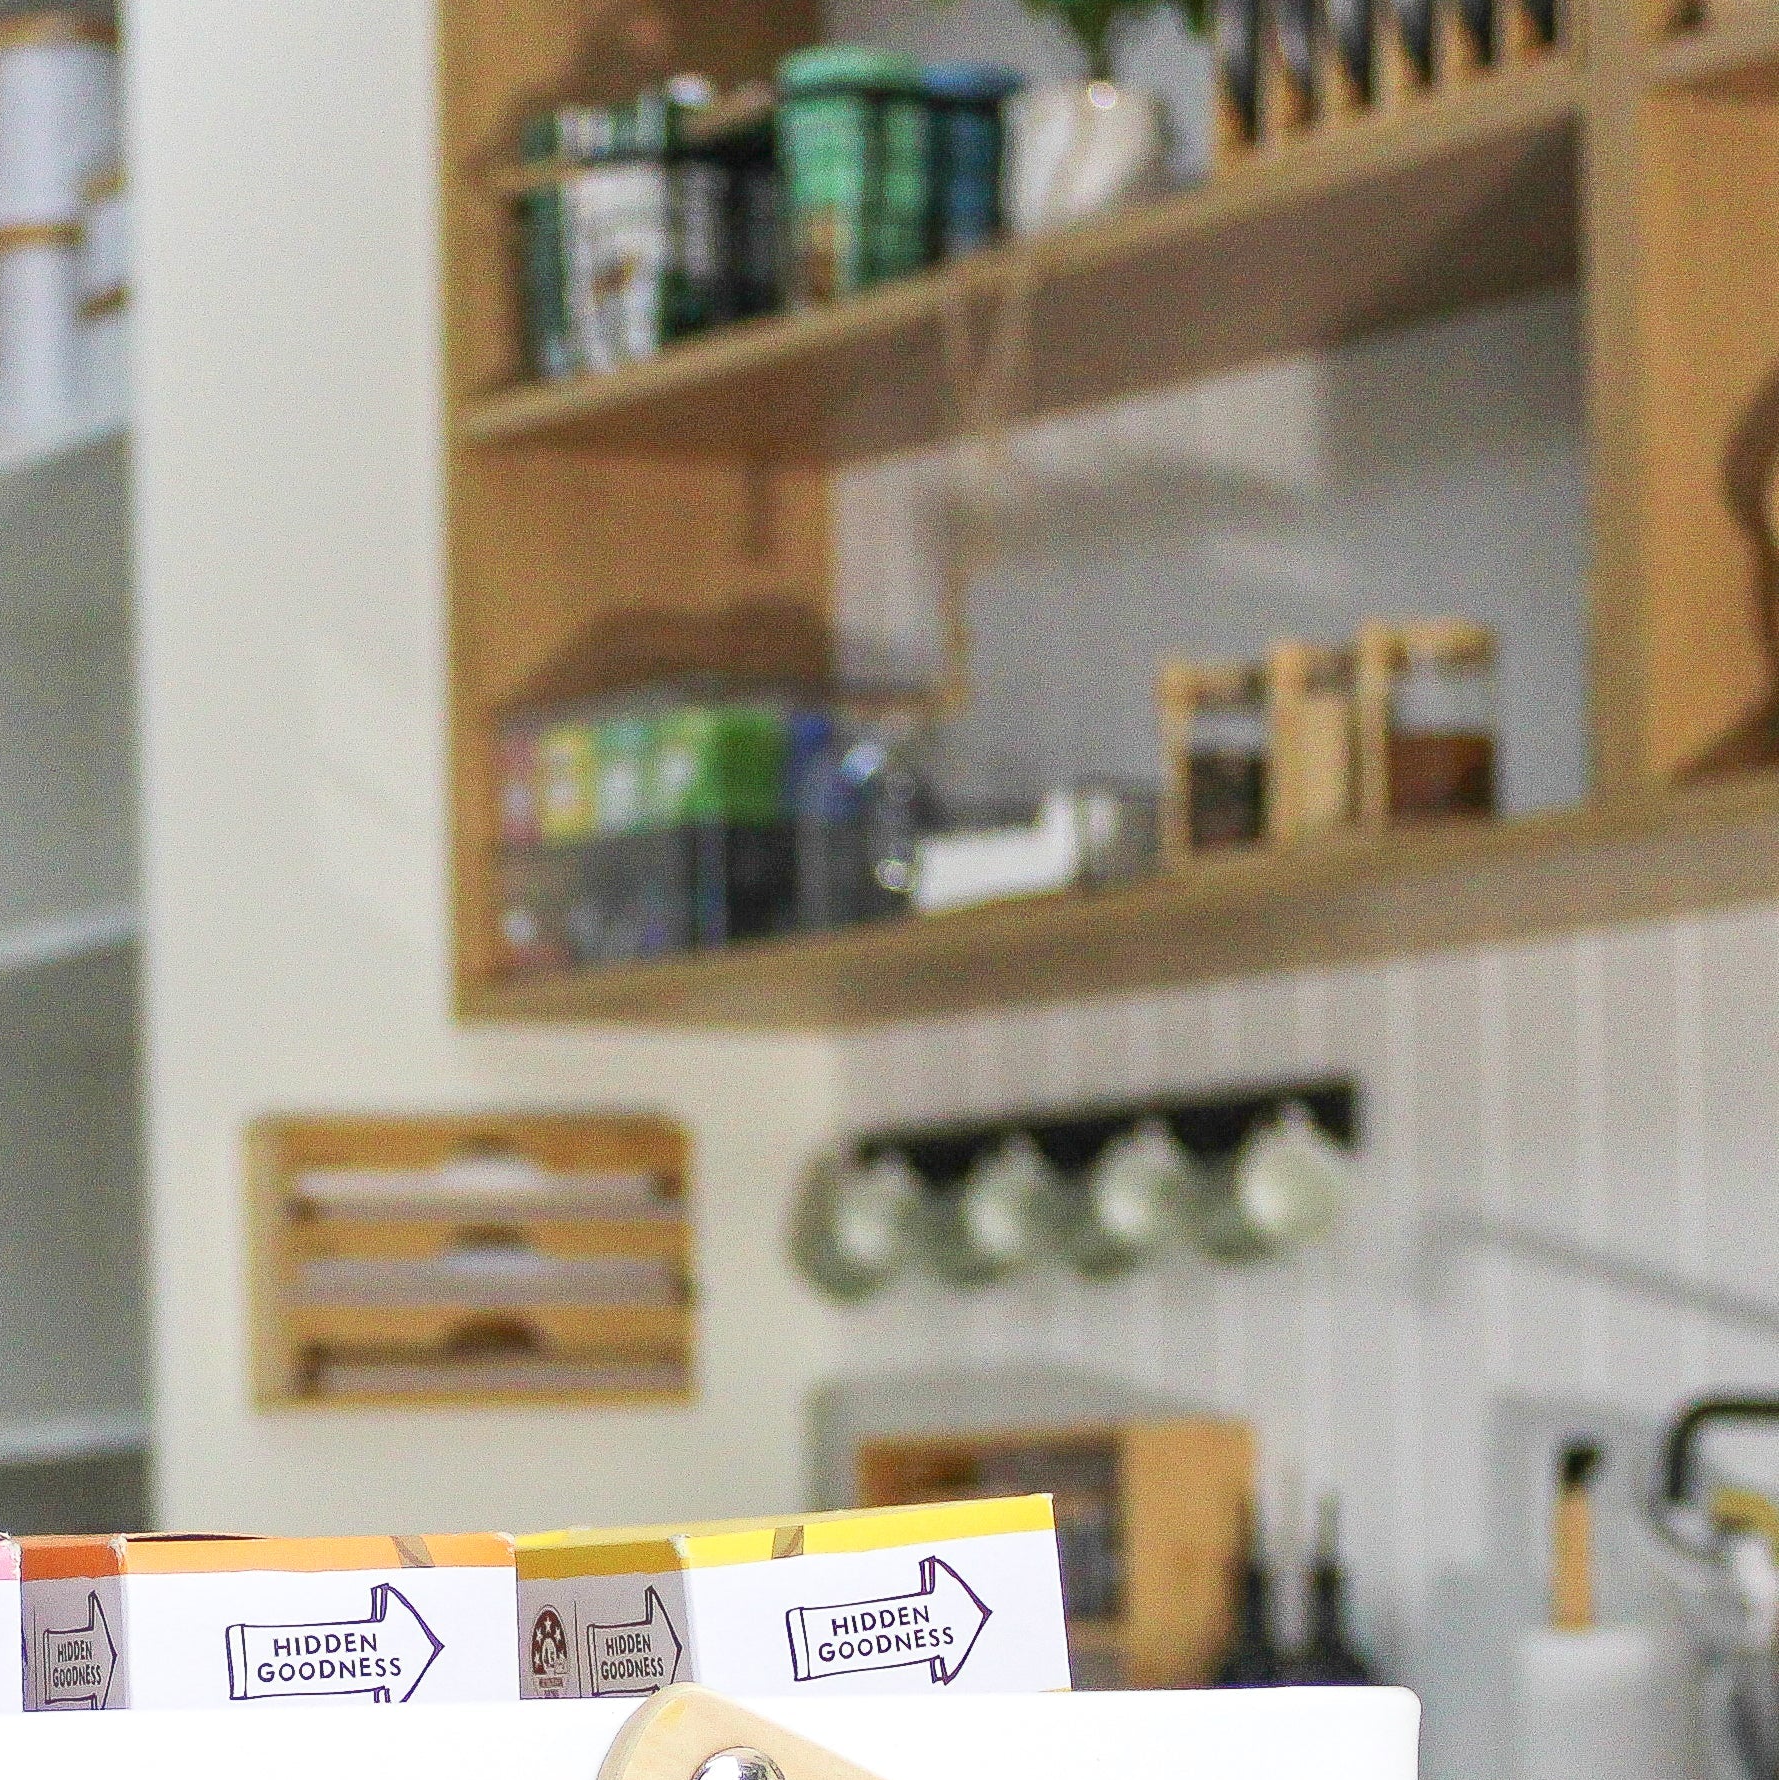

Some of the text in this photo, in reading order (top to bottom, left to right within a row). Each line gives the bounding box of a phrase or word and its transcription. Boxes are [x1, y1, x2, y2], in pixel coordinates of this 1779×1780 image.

[831, 1605, 929, 1636] HIDDEN
[57, 1640, 93, 1663] HIDDEN
[273, 1633, 377, 1657] HIDDEN
[605, 1633, 651, 1656] HIDDEN
[819, 1627, 954, 1662] GOODNESS
[53, 1664, 101, 1688] GOODNESS
[257, 1657, 401, 1682] GOODNESS
[601, 1657, 664, 1680] GOODNESS
